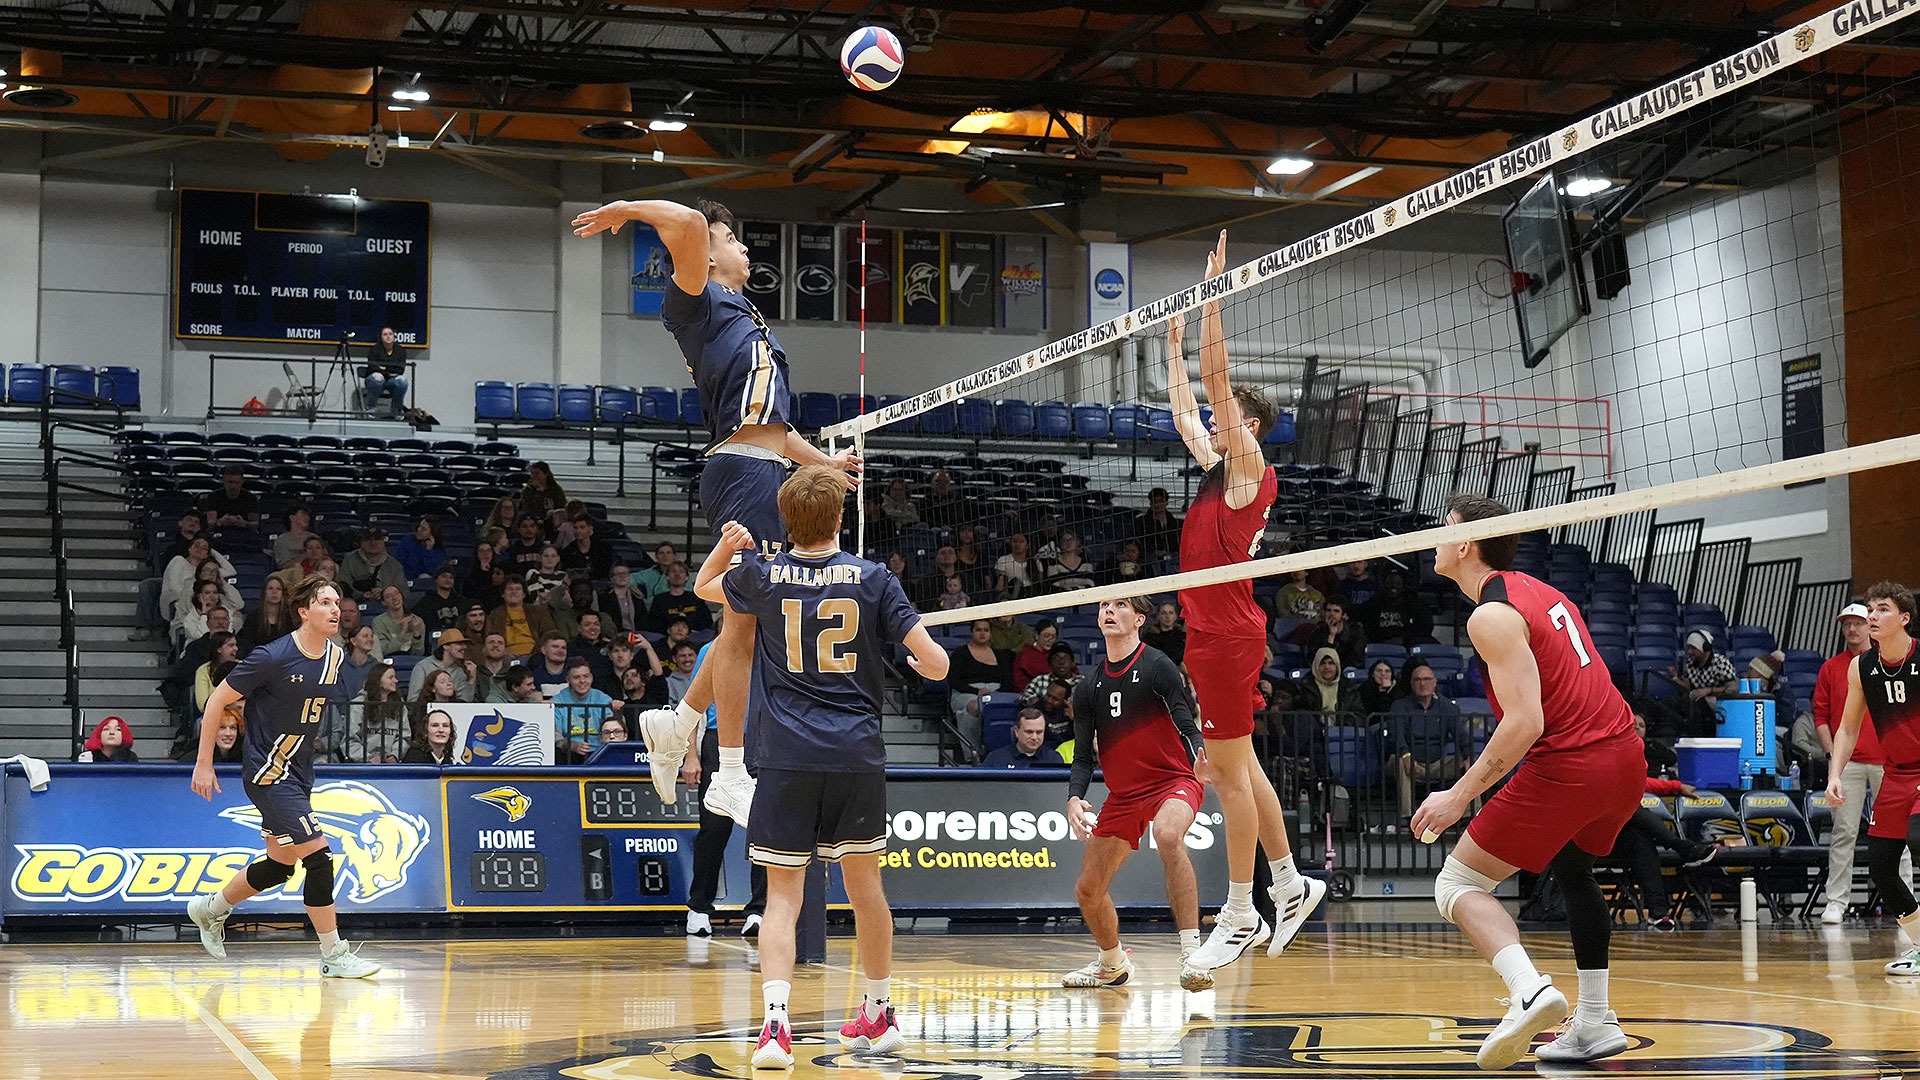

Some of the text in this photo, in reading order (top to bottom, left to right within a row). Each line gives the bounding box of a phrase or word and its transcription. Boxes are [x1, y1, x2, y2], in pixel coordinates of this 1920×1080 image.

[1833, 0, 1916, 37] GALL
[1591, 39, 1781, 140] GALLAUDET BISON
[1406, 138, 1552, 218] GALLAUDET BISON
[199, 230, 242, 246] HOME
[288, 242, 323, 255] PERIOD
[366, 238, 412, 254] GUEST
[1257, 213, 1375, 277] GALLAUDET BISON
[191, 282, 416, 303] FOULS T.O.L. PLAYER FOUL T.O.L. FOULS
[1001, 276, 1042, 287] WILSON
[1097, 282, 1125, 293] NCAA
[1137, 271, 1234, 325] GALLAUDET BISON
[190, 324, 222, 335] SCORE
[286, 328, 321, 340] MATCH
[1039, 320, 1118, 364] GALLAUDET BISON
[999, 357, 1022, 380] BISON
[922, 388, 942, 409] BISON
[770, 564, 862, 587] GALLAUDET
[781, 597, 860, 674] 12
[1546, 600, 1592, 669] 7
[1131, 669, 1140, 683] L
[1910, 663, 1919, 676] L
[1884, 680, 1906, 704] 18
[300, 697, 327, 724] 15
[1109, 691, 1122, 718] 9
[1755, 702, 1765, 755] POWERADE
[1685, 797, 1724, 806] BISON
[1750, 797, 1788, 806] BISON
[298, 811, 322, 836] 15
[478, 830, 678, 853] HOME PERIOD
[917, 846, 1057, 868] Connected.
[15, 848, 346, 895] GO BIS
